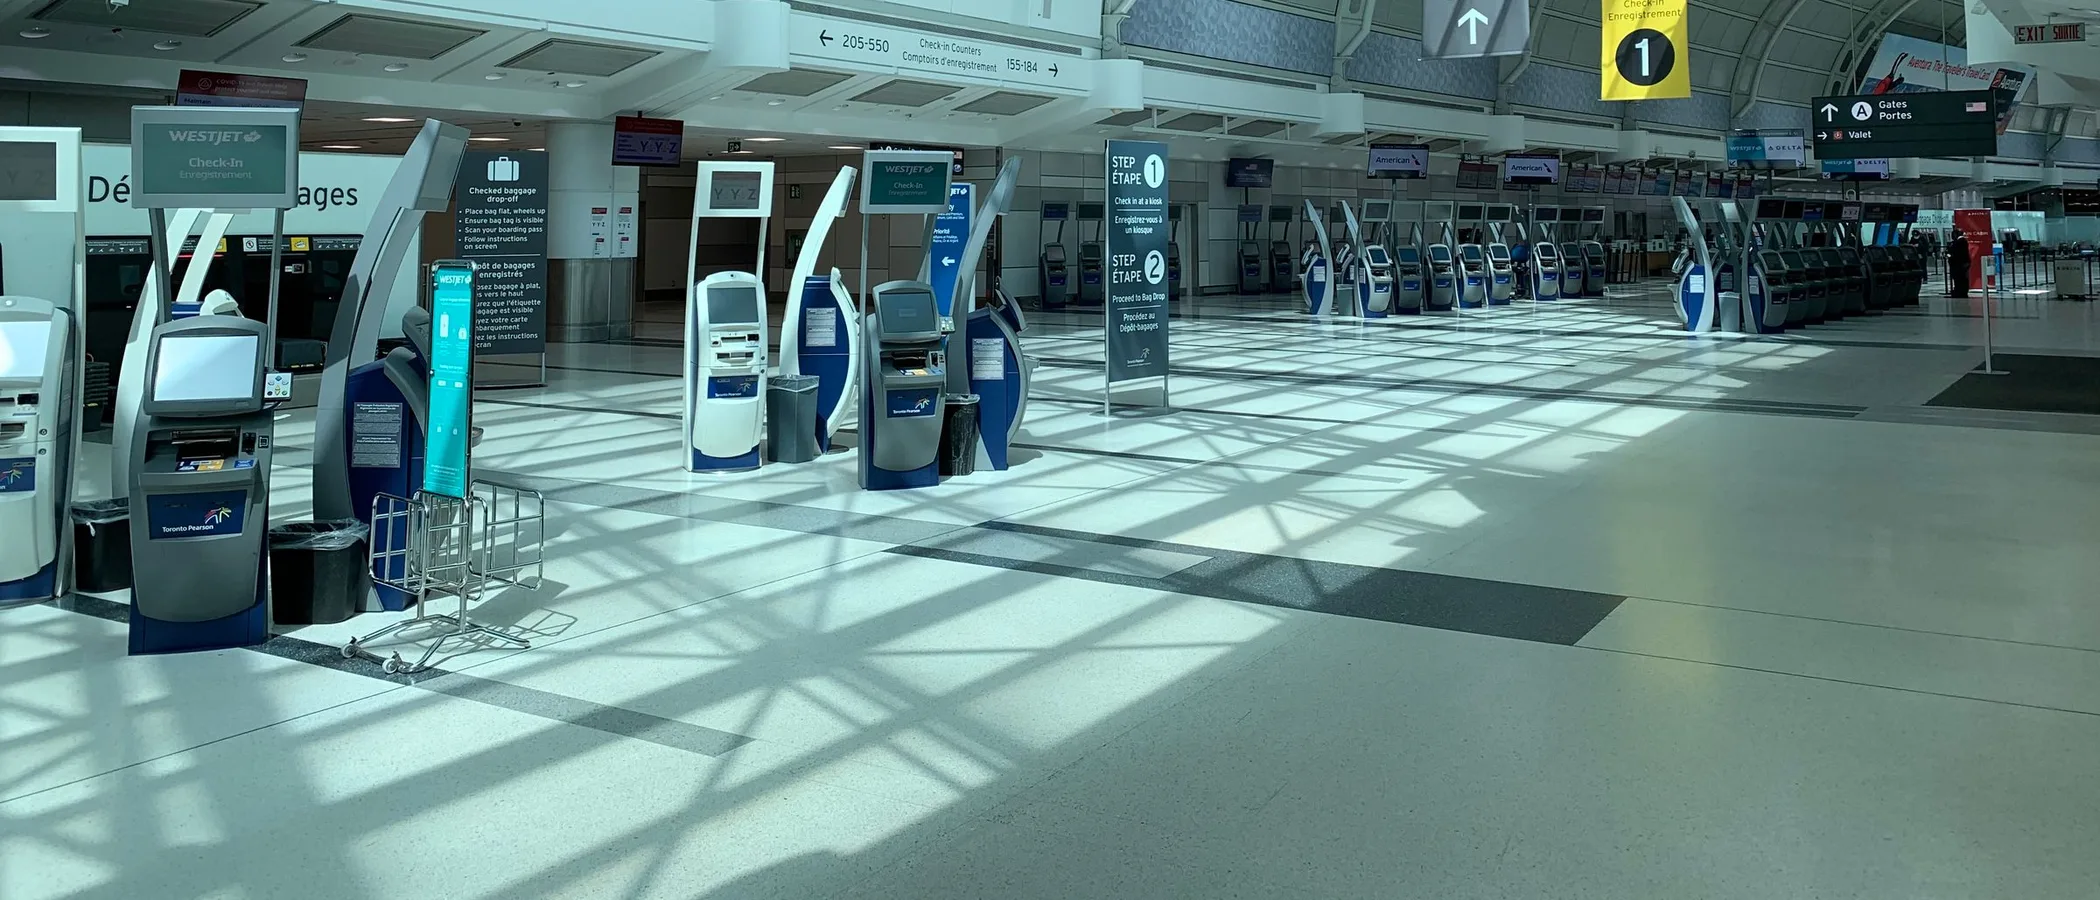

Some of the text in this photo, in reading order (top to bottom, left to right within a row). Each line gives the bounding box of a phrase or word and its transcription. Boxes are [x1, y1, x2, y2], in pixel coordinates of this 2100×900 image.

[1608, 9, 1681, 21] Enregistrement
[2018, 26, 2045, 41] EXIT
[842, 34, 890, 53] 205-550
[920, 38, 982, 57] Check-in Counters
[902, 51, 997, 73] Comptoirs d'enregistrement
[1635, 38, 1650, 76] 1
[1006, 58, 1038, 73] 155-184
[1856, 103, 1868, 117] A
[1878, 100, 1908, 109] Gates
[1879, 111, 1912, 120] Portes
[168, 130, 243, 145] WESTJET
[1848, 131, 1872, 139] Valet
[188, 157, 243, 168] Check-In
[1112, 156, 1136, 168] STEP
[1375, 156, 1410, 164] American
[180, 170, 252, 181] Enregistrement
[885, 165, 924, 175] WESTJET
[1150, 159, 1156, 183] 1
[1112, 169, 1142, 185] ÉTAPE
[504, 187, 537, 196] baggage
[286, 187, 358, 212] ages
[1114, 196, 1131, 205] Check
[1132, 197, 1137, 205] in
[1138, 197, 1144, 205] at
[1149, 197, 1163, 205] kiosk
[1114, 215, 1163, 225] Enregistrez-vous à
[1133, 226, 1153, 235] kiosque
[492, 262, 502, 270] de
[503, 262, 536, 270] bagages
[1112, 254, 1136, 267] STEP
[1149, 254, 1160, 279] 2
[479, 270, 523, 279] enregistrés
[1112, 268, 1142, 284] ÉTAPE
[439, 275, 465, 286] WESTJET
[1112, 294, 1135, 303] Proceed
[1142, 293, 1152, 302] Bag
[1153, 292, 1166, 302] Drop
[1123, 312, 1148, 321] Procédez
[1119, 322, 1159, 333] Dépôt-bagages
[162, 524, 214, 533] Toronto Pearson
